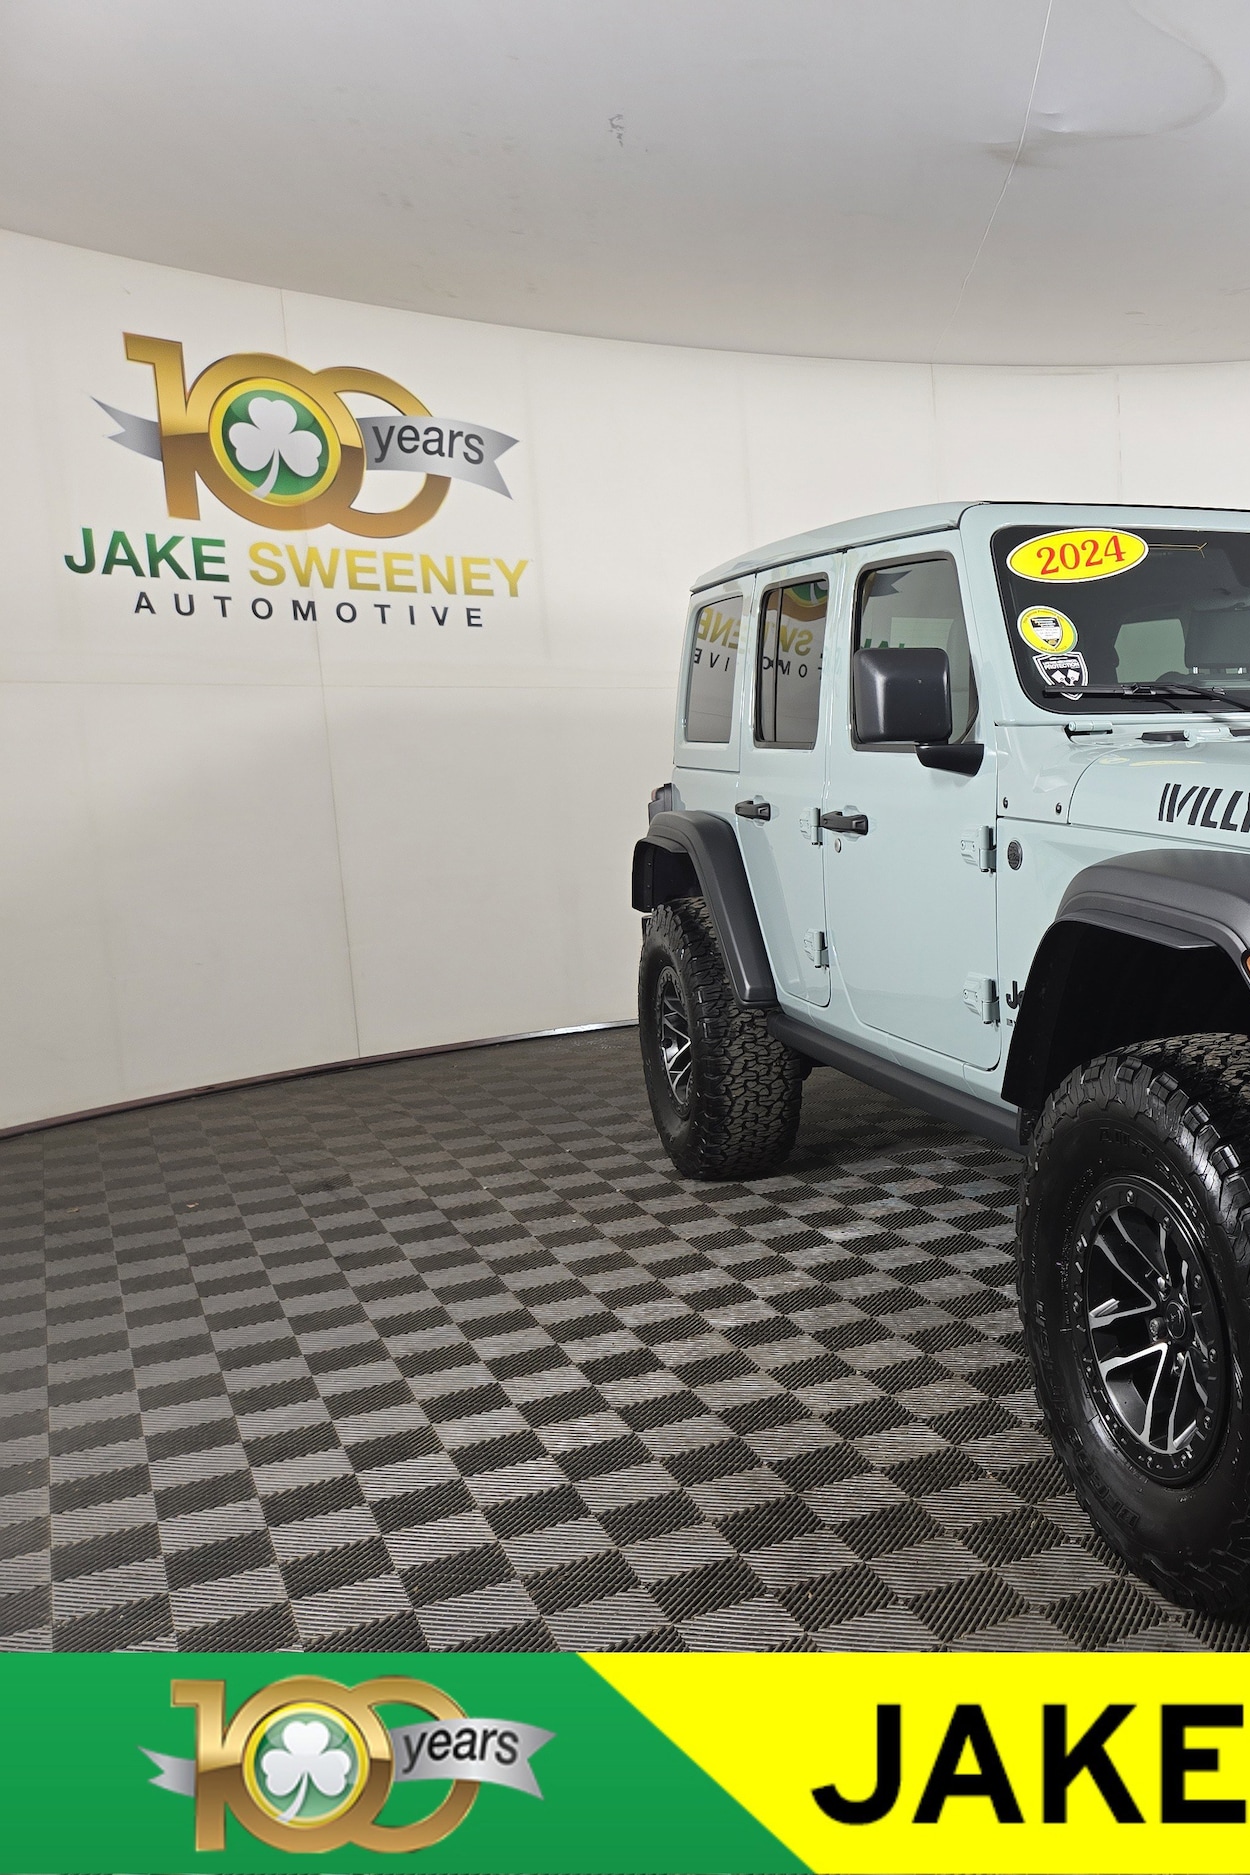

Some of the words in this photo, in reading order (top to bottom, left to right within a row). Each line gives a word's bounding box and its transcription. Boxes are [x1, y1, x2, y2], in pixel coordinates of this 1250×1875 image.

[122, 332, 452, 539] 100
[371, 421, 486, 465] years
[63, 527, 231, 583] JAKE
[248, 541, 529, 598] SWEENEY
[1036, 535, 1127, 575] 2024
[133, 591, 484, 628] AUTOMOTIVE
